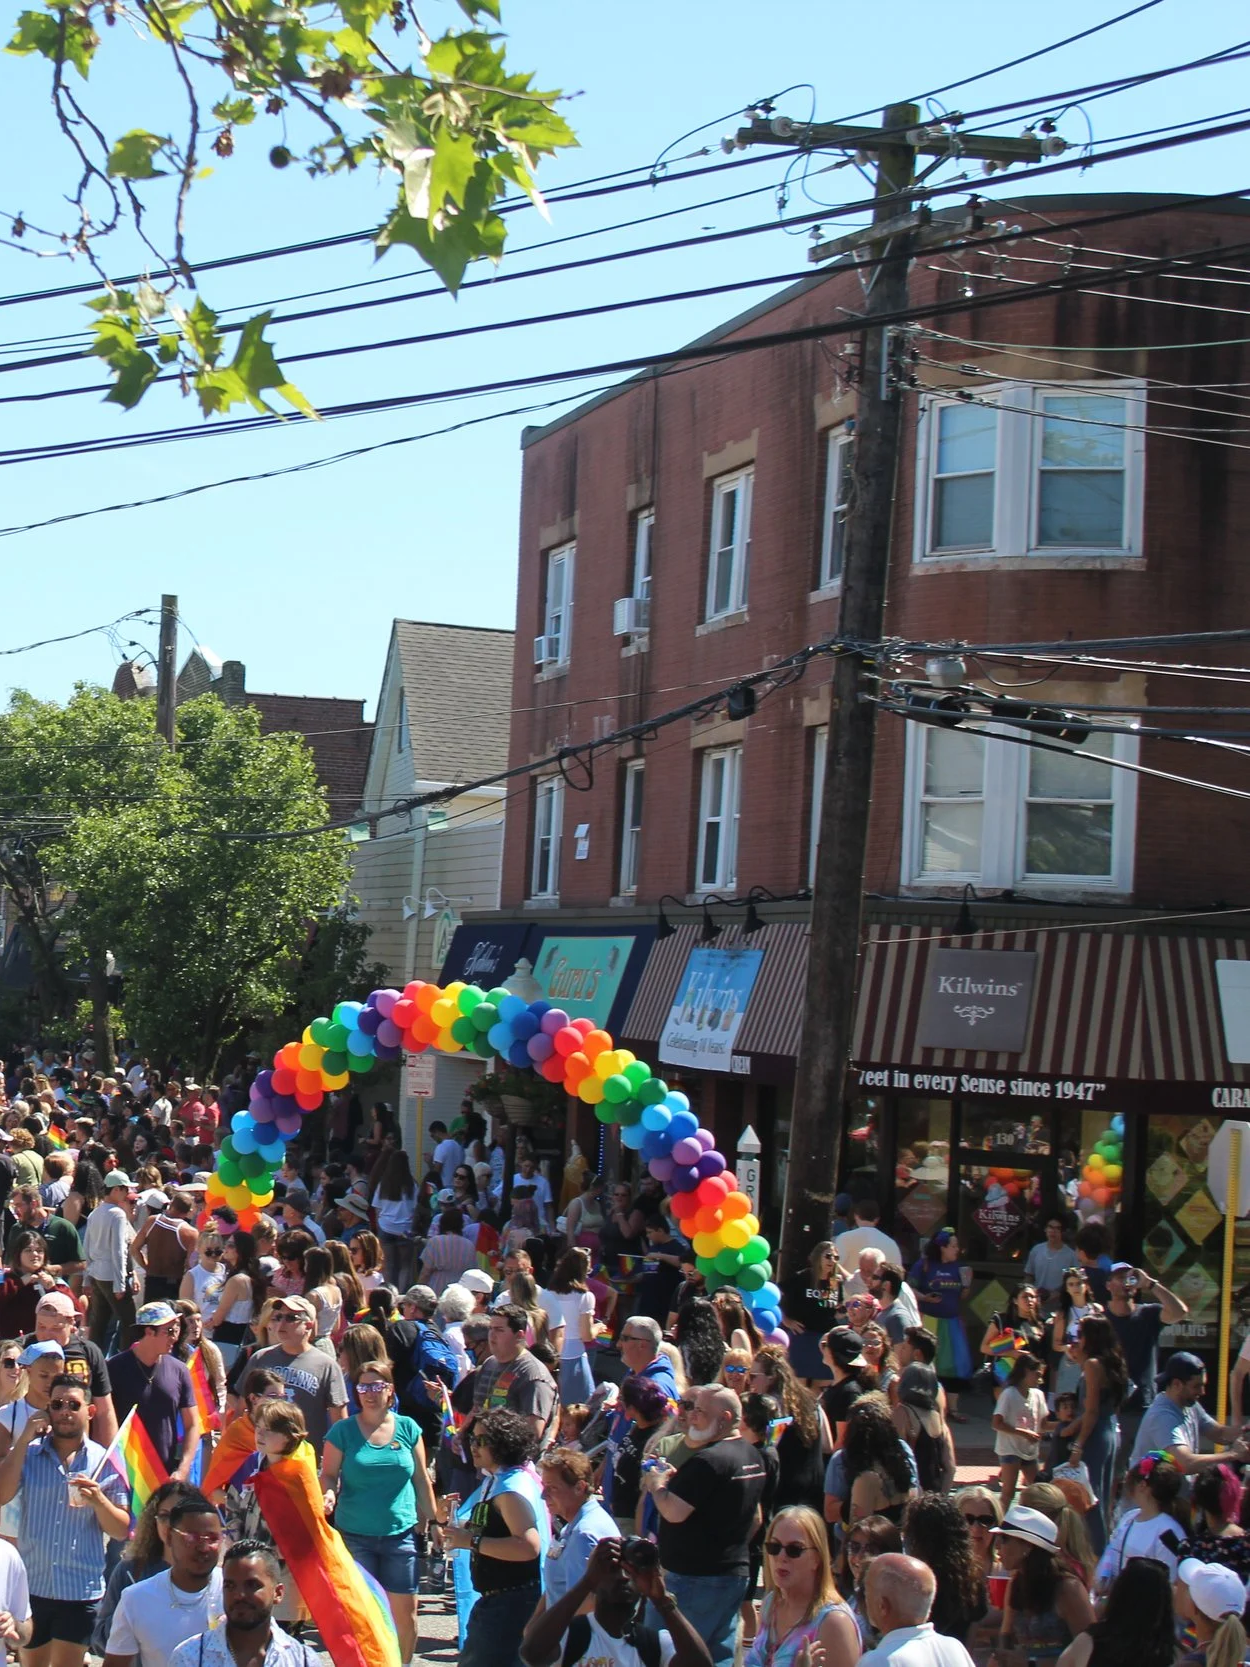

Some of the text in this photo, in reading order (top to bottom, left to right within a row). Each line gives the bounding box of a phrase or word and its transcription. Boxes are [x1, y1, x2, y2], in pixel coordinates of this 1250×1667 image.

[937, 976, 1018, 996] Kilwins
[894, 1070, 910, 1088] in
[913, 1074, 957, 1093] every
[961, 1074, 1006, 1095] Sense
[1010, 1078, 1051, 1097] since
[995, 1133, 1015, 1146] 130
